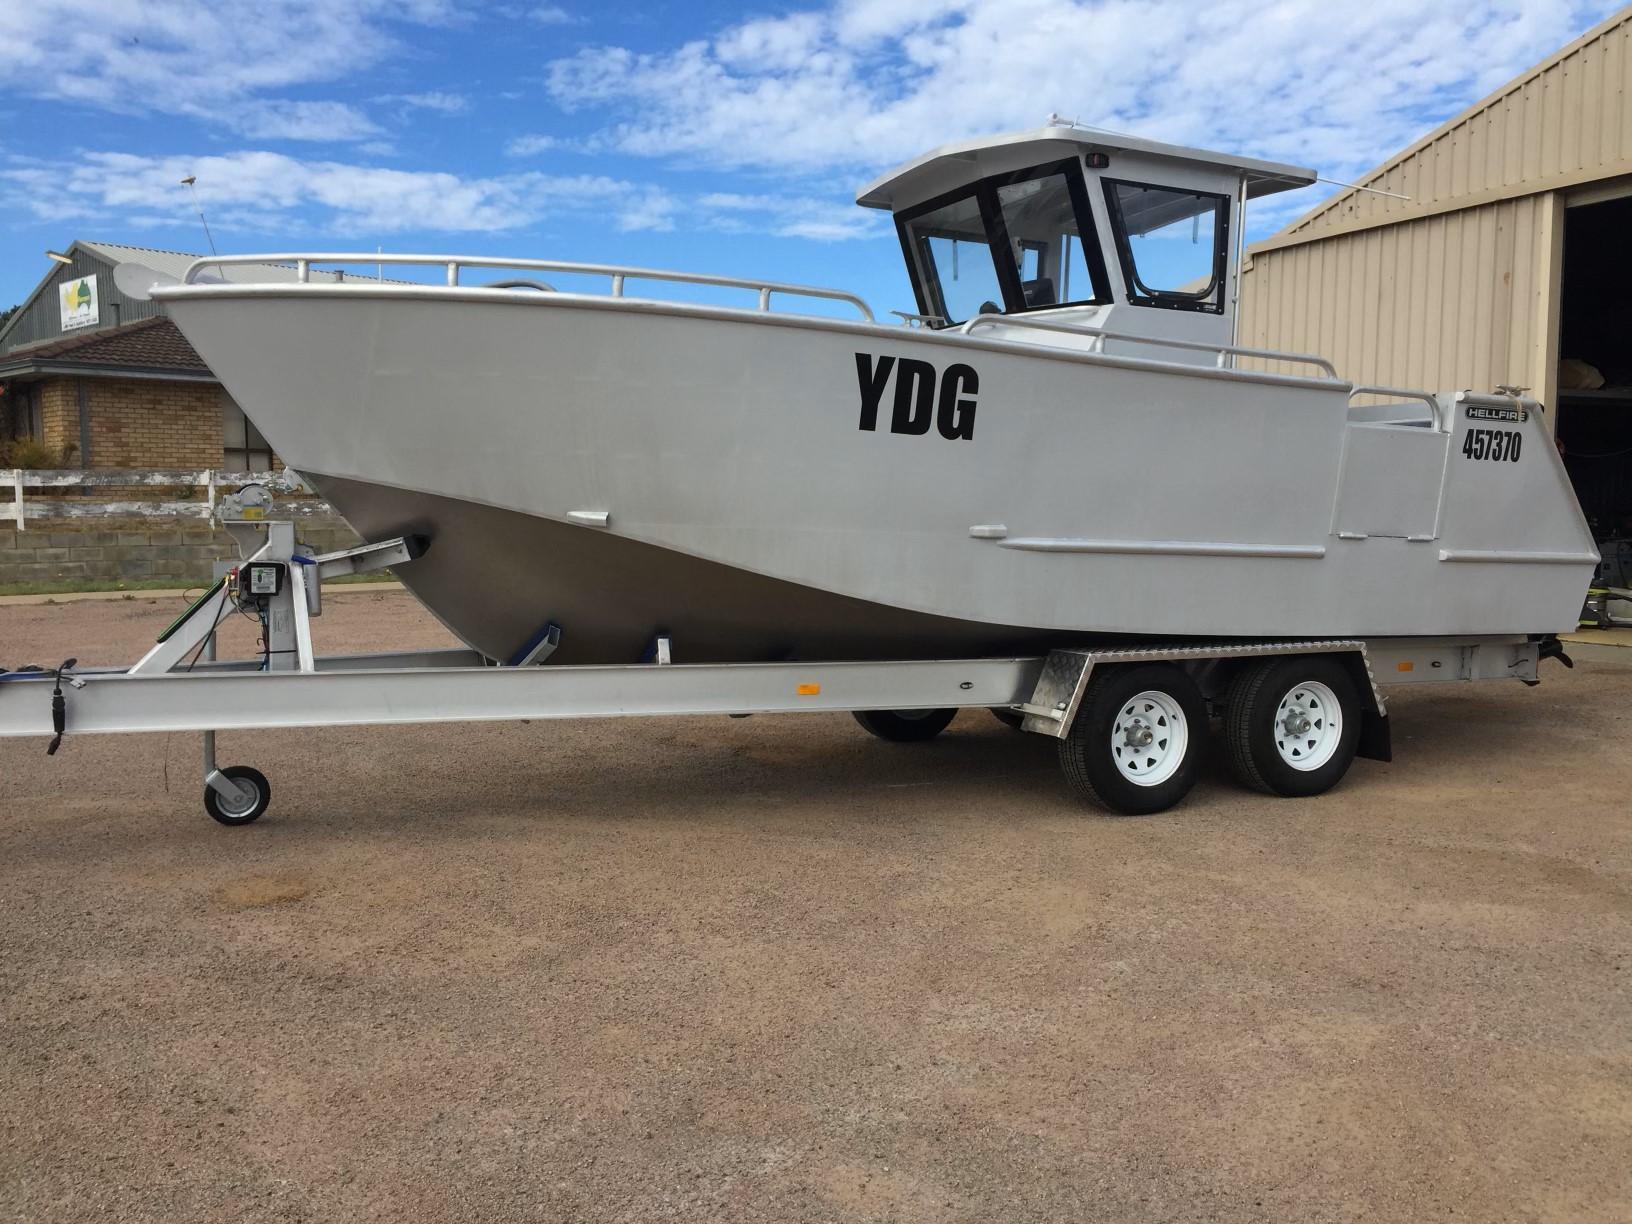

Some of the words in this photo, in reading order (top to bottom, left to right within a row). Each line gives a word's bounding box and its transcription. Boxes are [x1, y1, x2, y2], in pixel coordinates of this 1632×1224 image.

[855, 352, 979, 441] YDG
[1468, 407, 1526, 421] HELLFIRE
[1462, 429, 1522, 463] 457370
